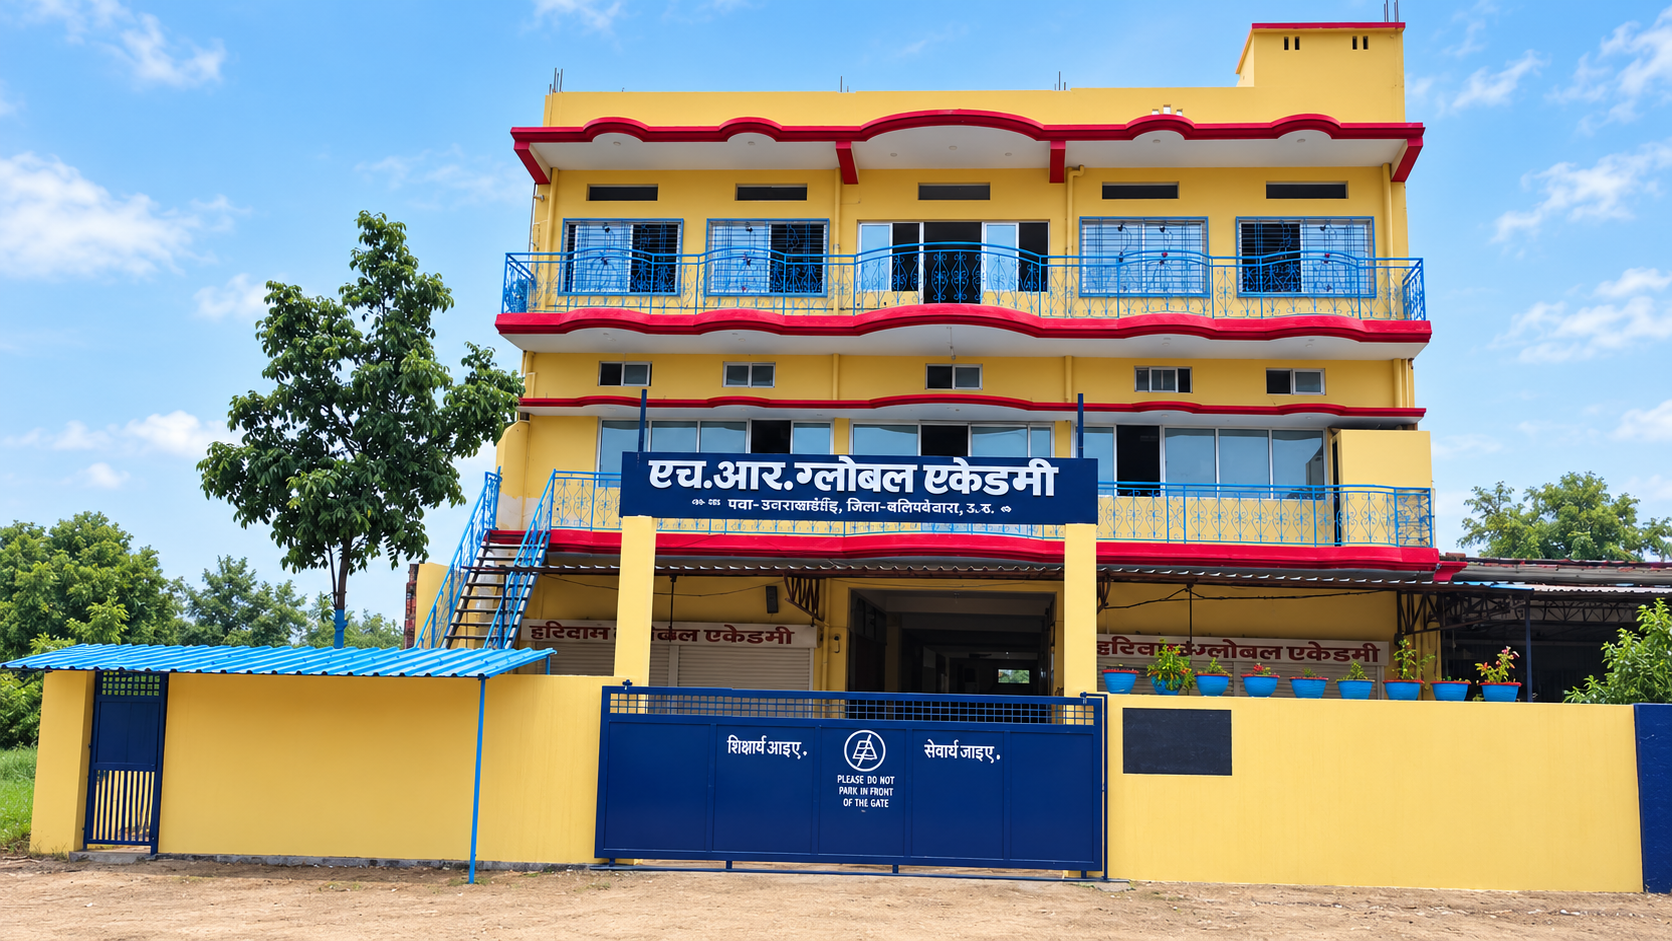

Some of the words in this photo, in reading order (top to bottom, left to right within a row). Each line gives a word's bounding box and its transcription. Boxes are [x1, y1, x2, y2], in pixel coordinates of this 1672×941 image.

[922, 457, 1059, 496] एकेडमी
[703, 624, 795, 644] एकेडमी
[1286, 641, 1380, 663] एकेडमी
[837, 774, 864, 785] PLEASE
[867, 775, 878, 785] DO
[880, 775, 895, 785] NOT
[838, 786, 858, 796] PARK
[860, 787, 869, 796] IN
[870, 787, 894, 797] FRONT
[842, 797, 853, 807] OF
[854, 798, 869, 808] THE
[870, 798, 889, 808] GATE
